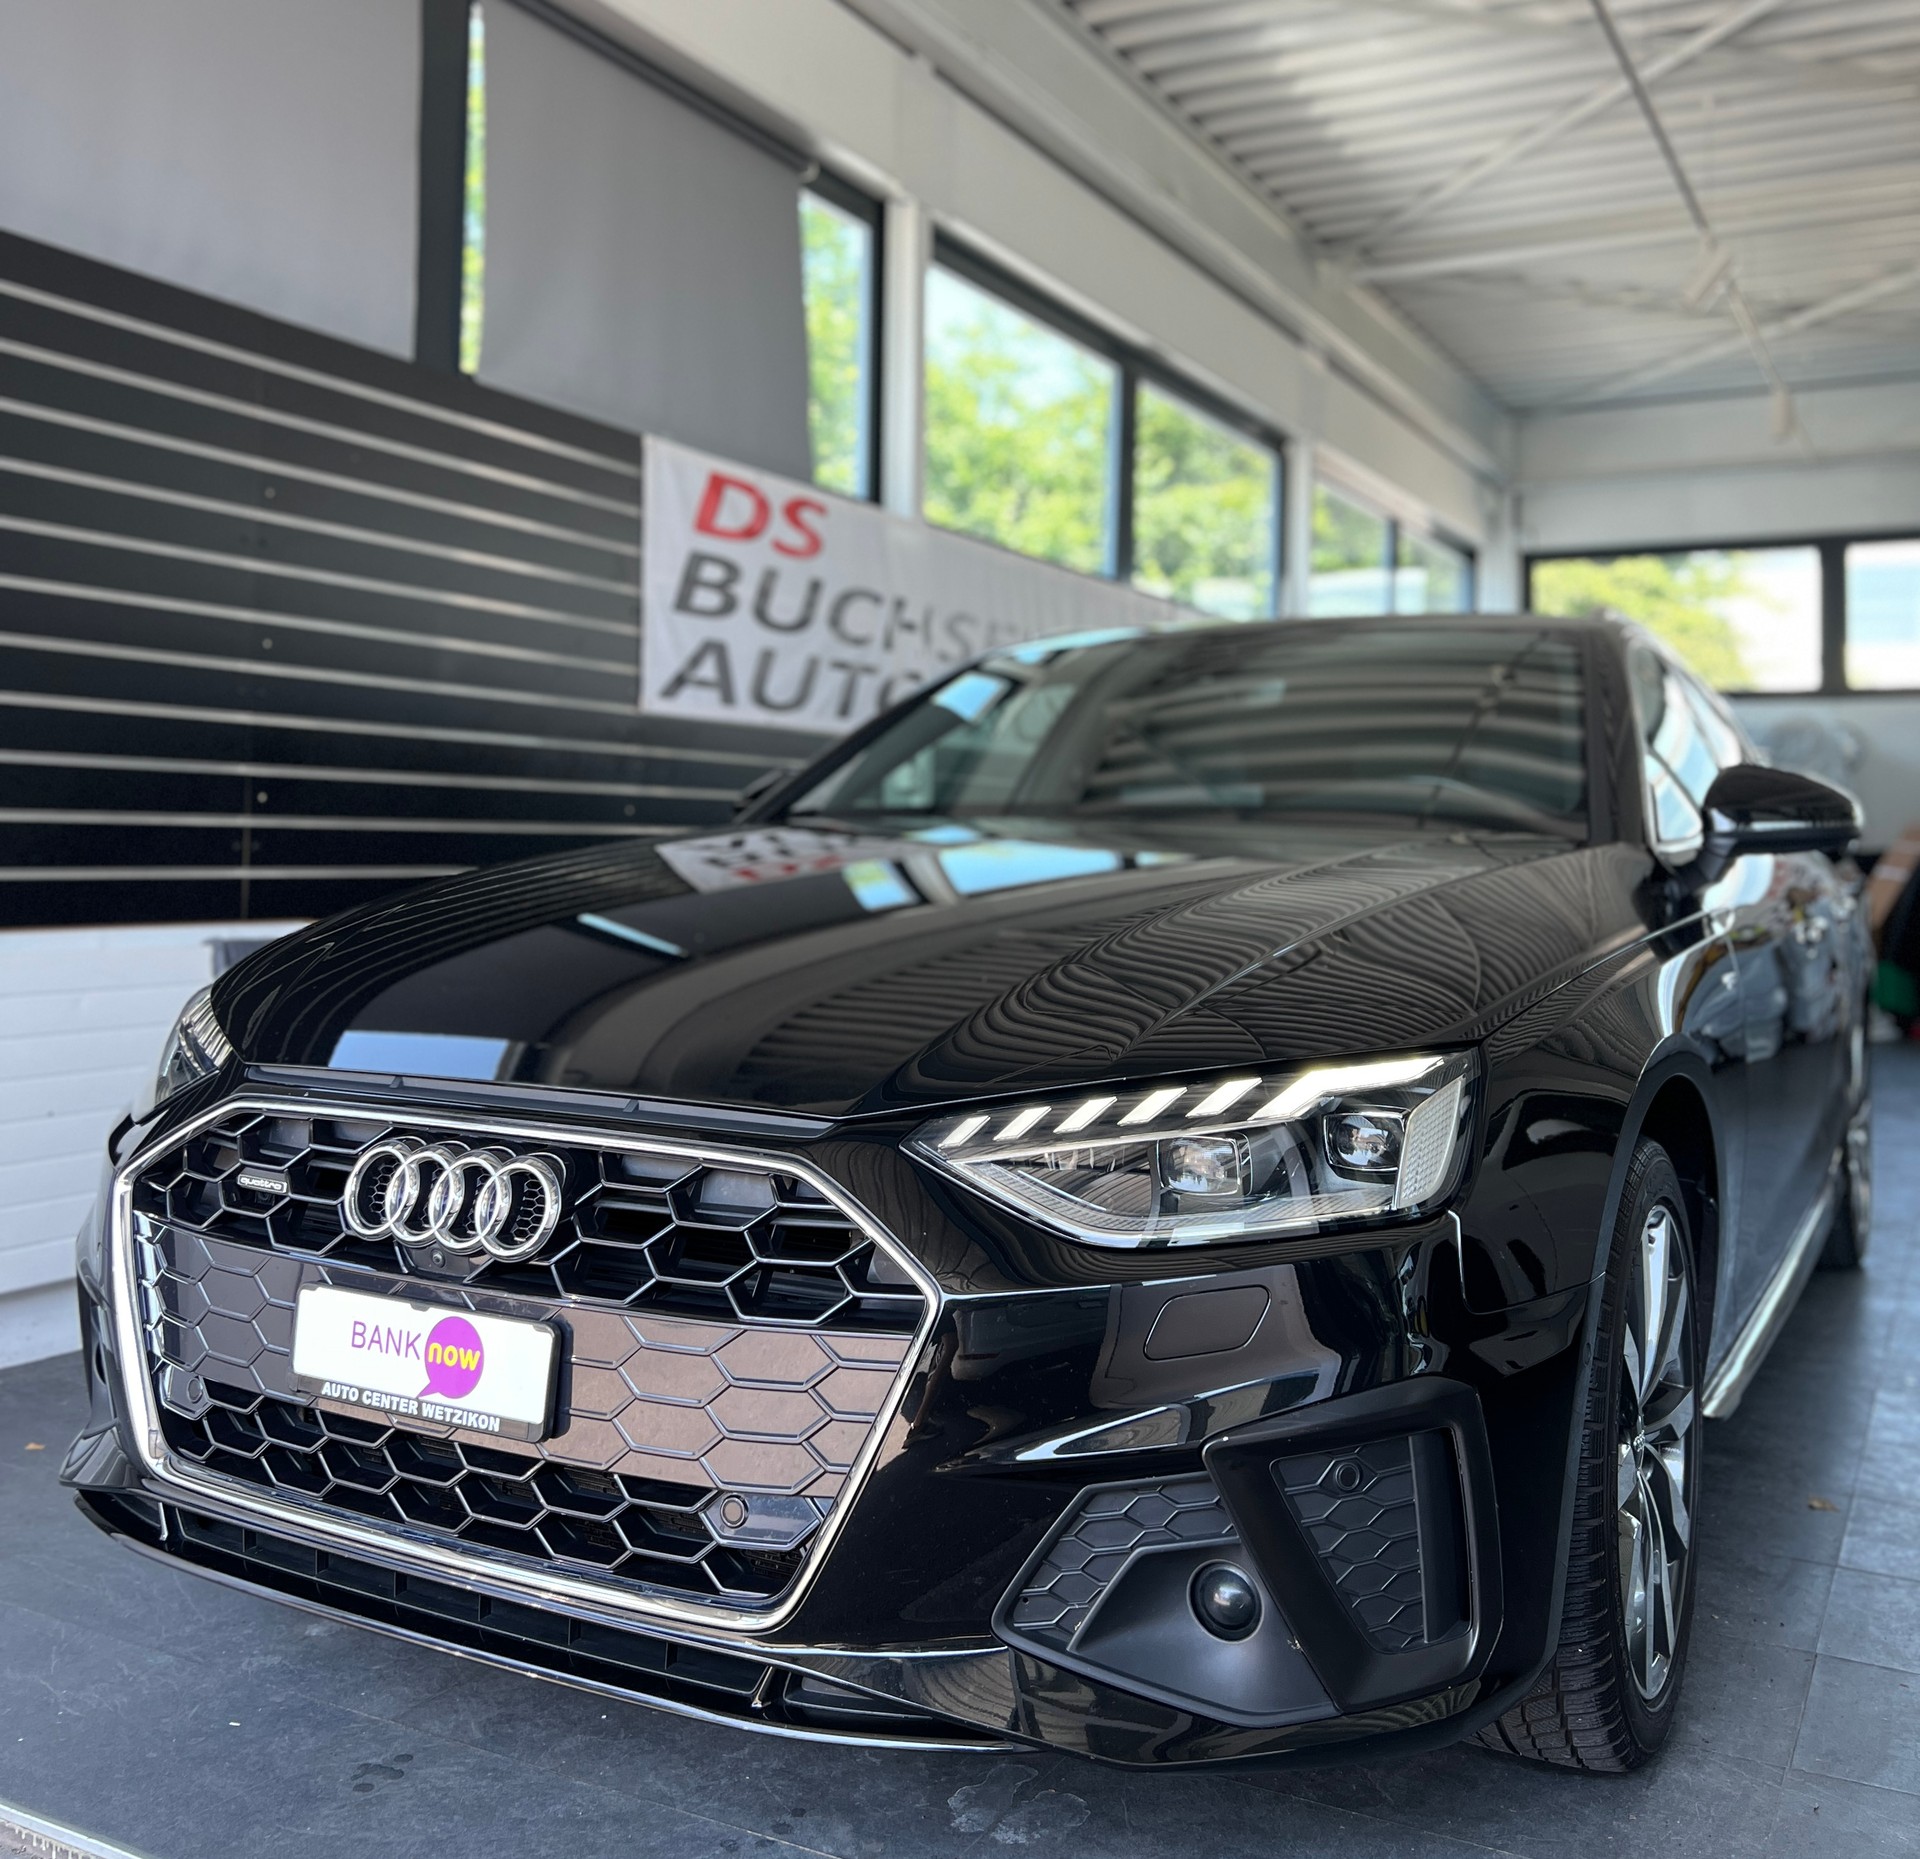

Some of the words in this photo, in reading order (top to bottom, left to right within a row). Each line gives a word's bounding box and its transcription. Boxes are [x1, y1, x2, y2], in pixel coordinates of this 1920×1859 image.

[695, 471, 828, 560] DS
[240, 1177, 283, 1190] quattro
[351, 1320, 422, 1361] BANK
[427, 1342, 481, 1372] now
[321, 1381, 360, 1402] AUTO
[362, 1390, 419, 1416] CENTER
[421, 1402, 500, 1432] WETZIKON
